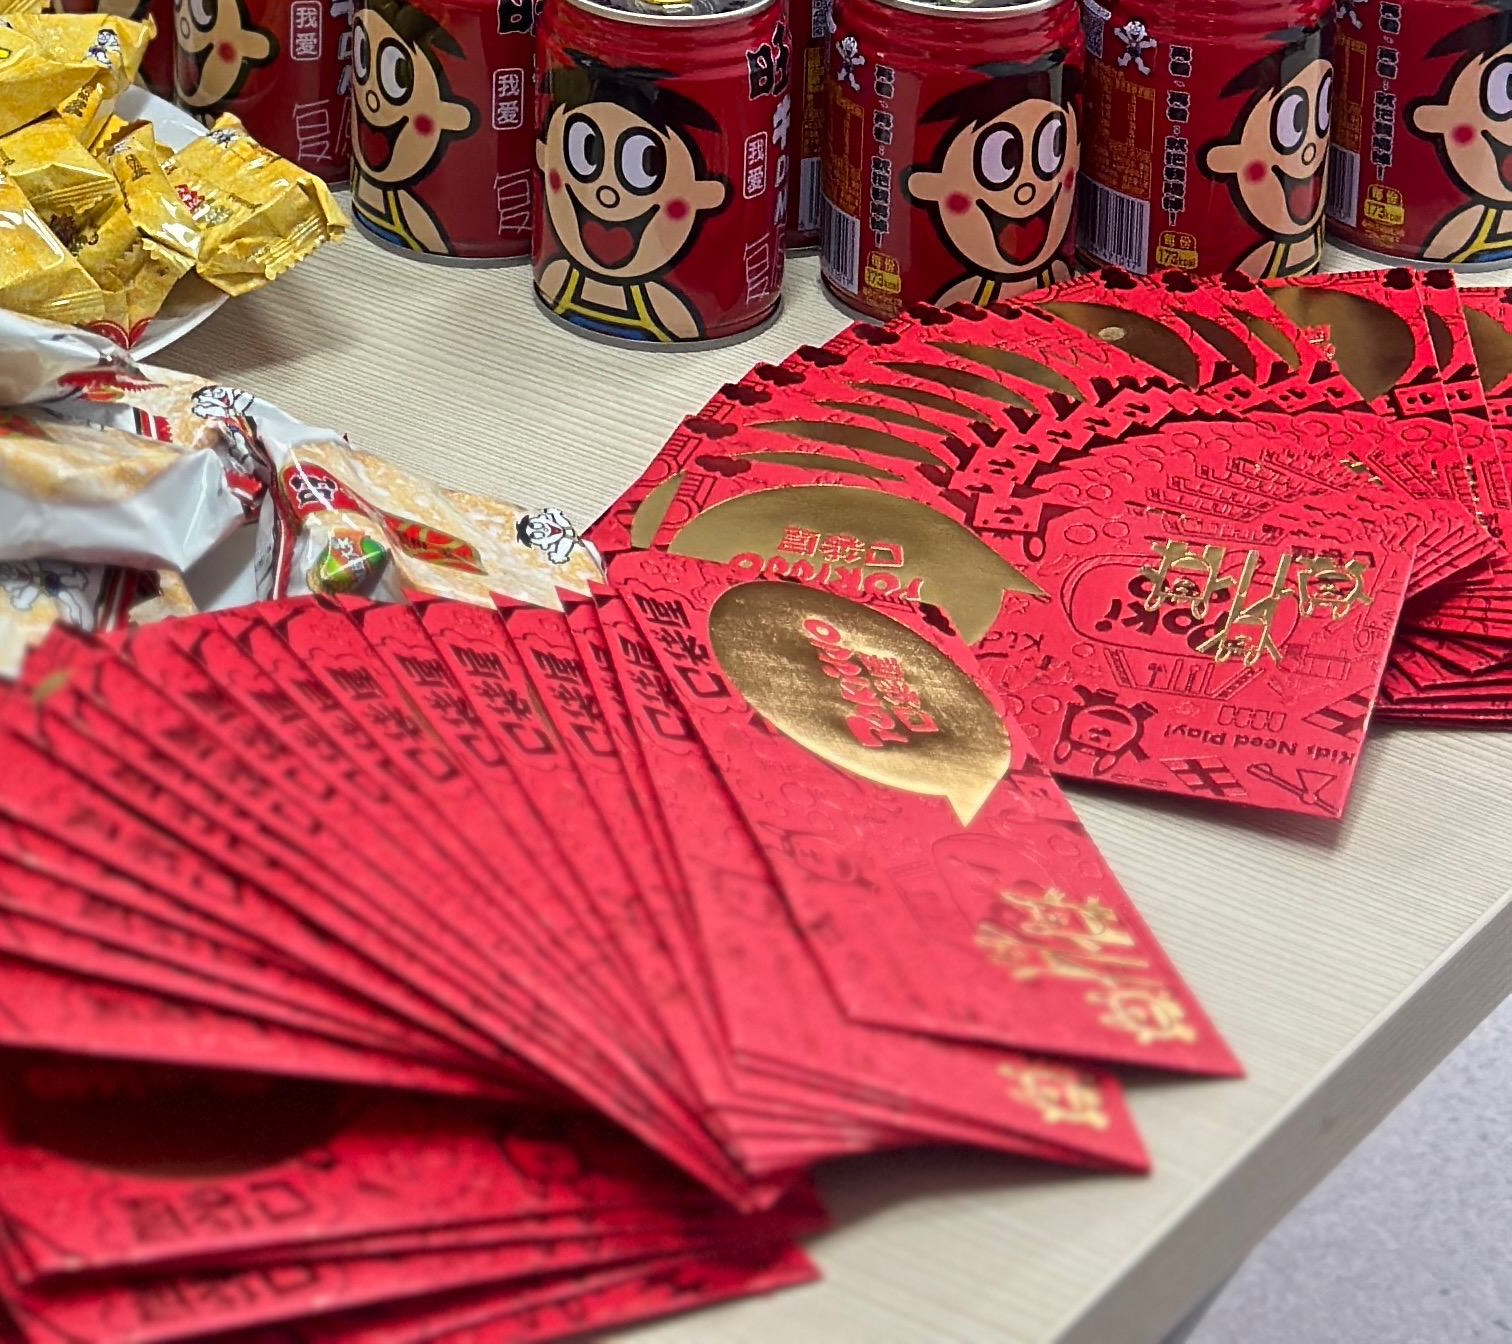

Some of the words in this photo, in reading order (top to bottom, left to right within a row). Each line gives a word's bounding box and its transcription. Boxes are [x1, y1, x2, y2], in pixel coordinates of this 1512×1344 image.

[295, 5, 319, 56] 我爱
[497, 73, 521, 127] 我爱
[747, 138, 766, 193] 我爱
[630, 590, 731, 700] 口袋屋
[449, 642, 556, 757] 口袋屋
[1163, 721, 1227, 748] Play!
[1232, 732, 1300, 757] Need
